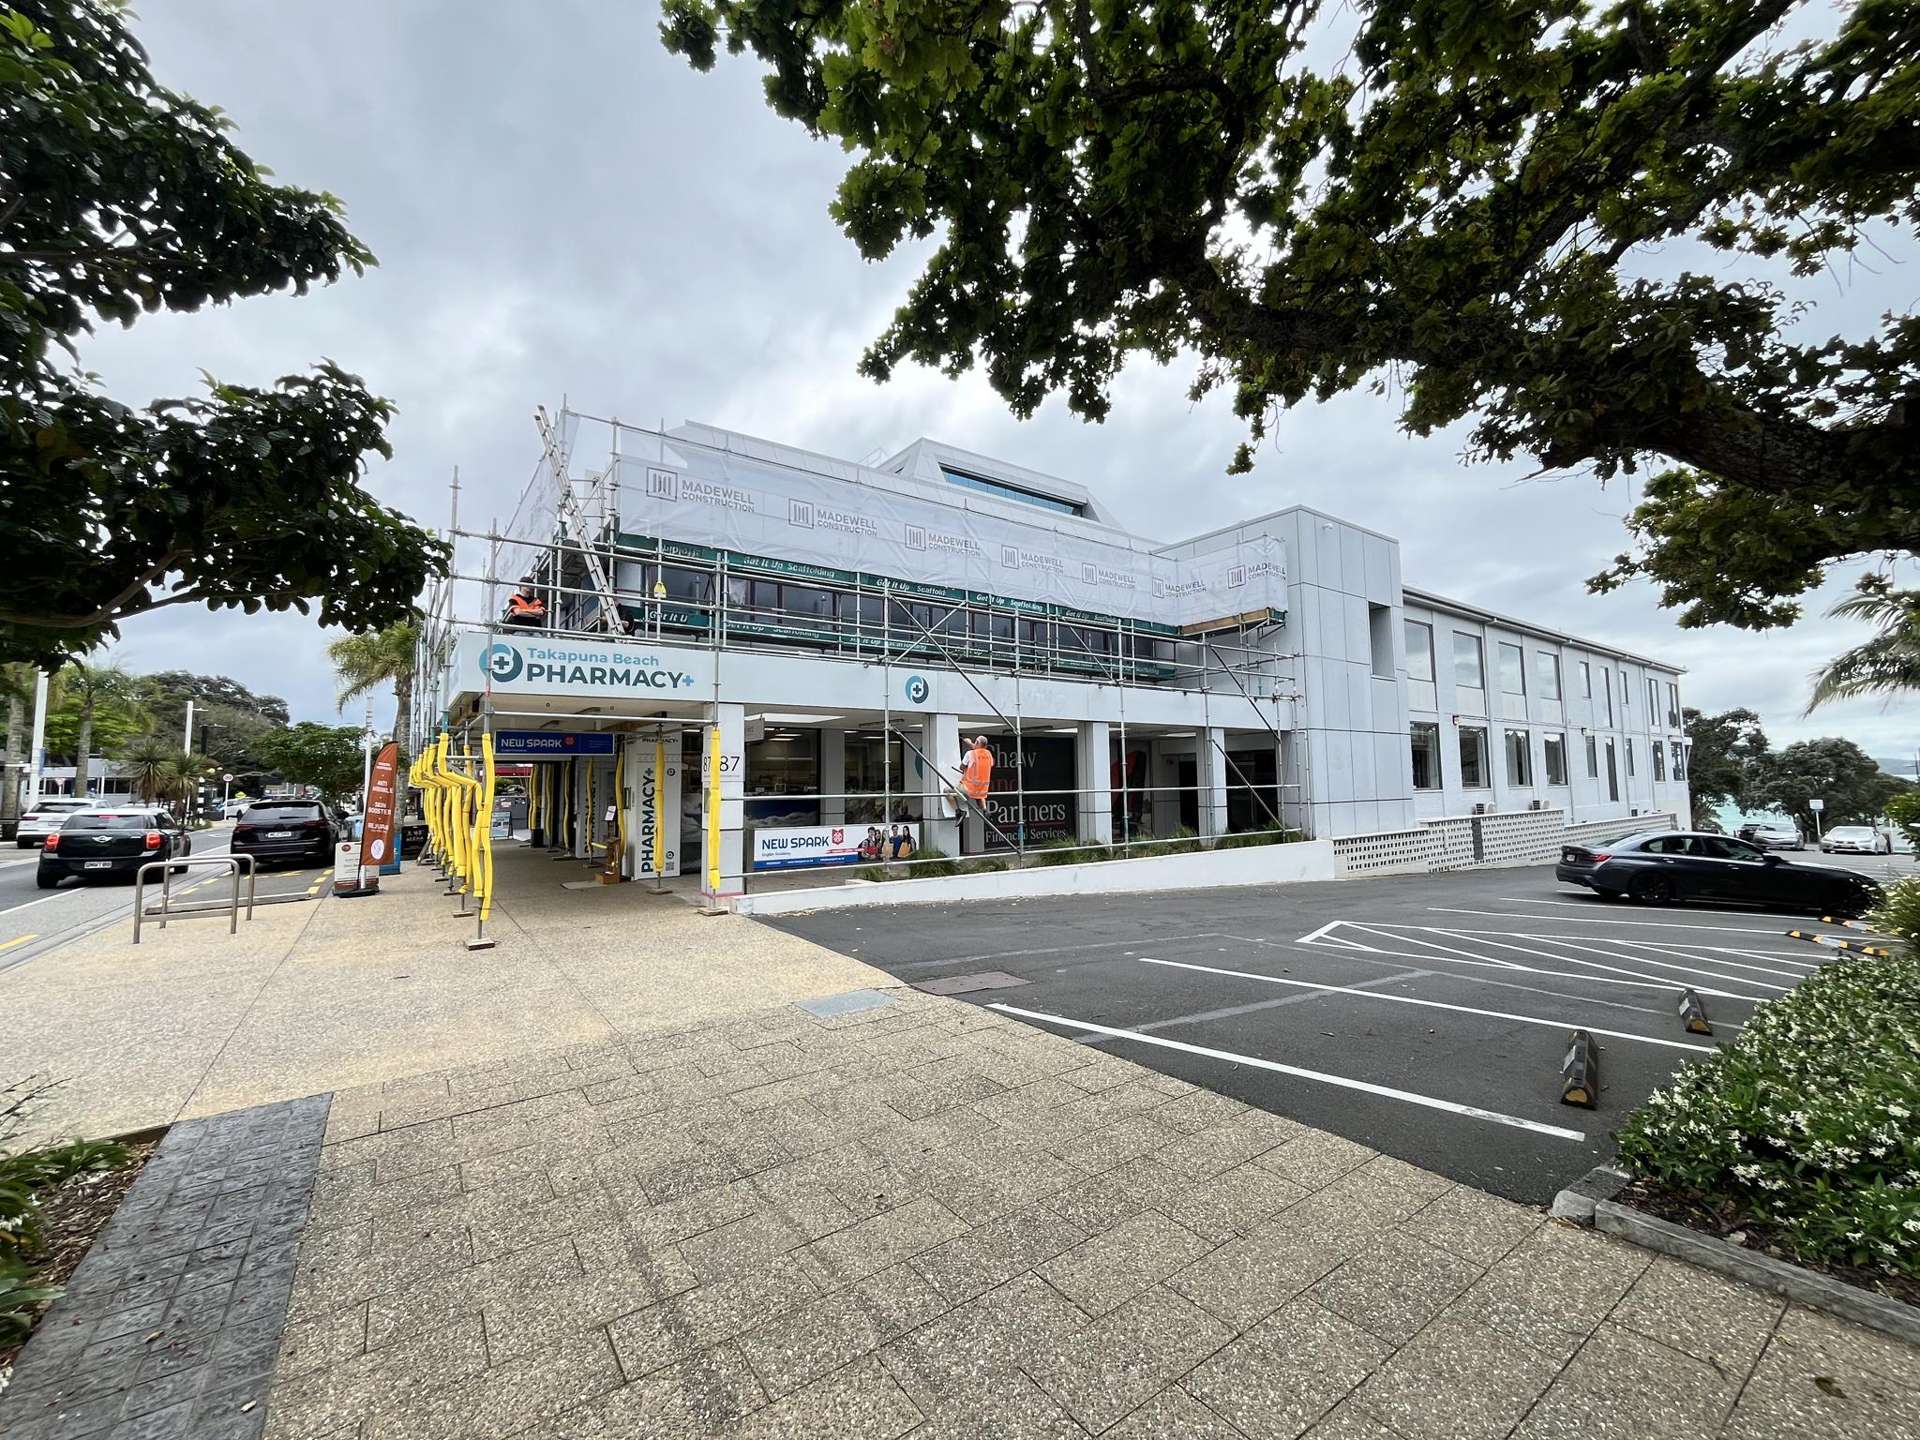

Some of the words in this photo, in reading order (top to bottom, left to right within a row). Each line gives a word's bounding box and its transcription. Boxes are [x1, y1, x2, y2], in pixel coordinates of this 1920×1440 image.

[681, 479, 754, 505] MADEWELL
[681, 491, 755, 513] CONSTRUCTION
[817, 509, 878, 530] MADEWELL
[817, 520, 878, 536] CONSTRUCTION
[928, 533, 981, 550] MADEWELL
[928, 543, 981, 557] CONSTRUCTION
[1021, 552, 1064, 568] MADEWELL
[1021, 562, 1064, 574] CONSTRUCTION
[788, 563, 836, 579] Scaffolding
[1099, 570, 1136, 583] MADEWELL
[1248, 562, 1286, 575] MADEWELL
[1165, 580, 1206, 593] MADEWELL
[527, 647, 608, 664] Takapuna
[611, 653, 659, 667] Beach
[501, 739, 524, 747] NEW
[527, 739, 562, 748] SPARK
[720, 756, 740, 772] 87
[1030, 827, 1066, 840] Services
[762, 838, 788, 850] NEW
[791, 836, 829, 848] SPARK
